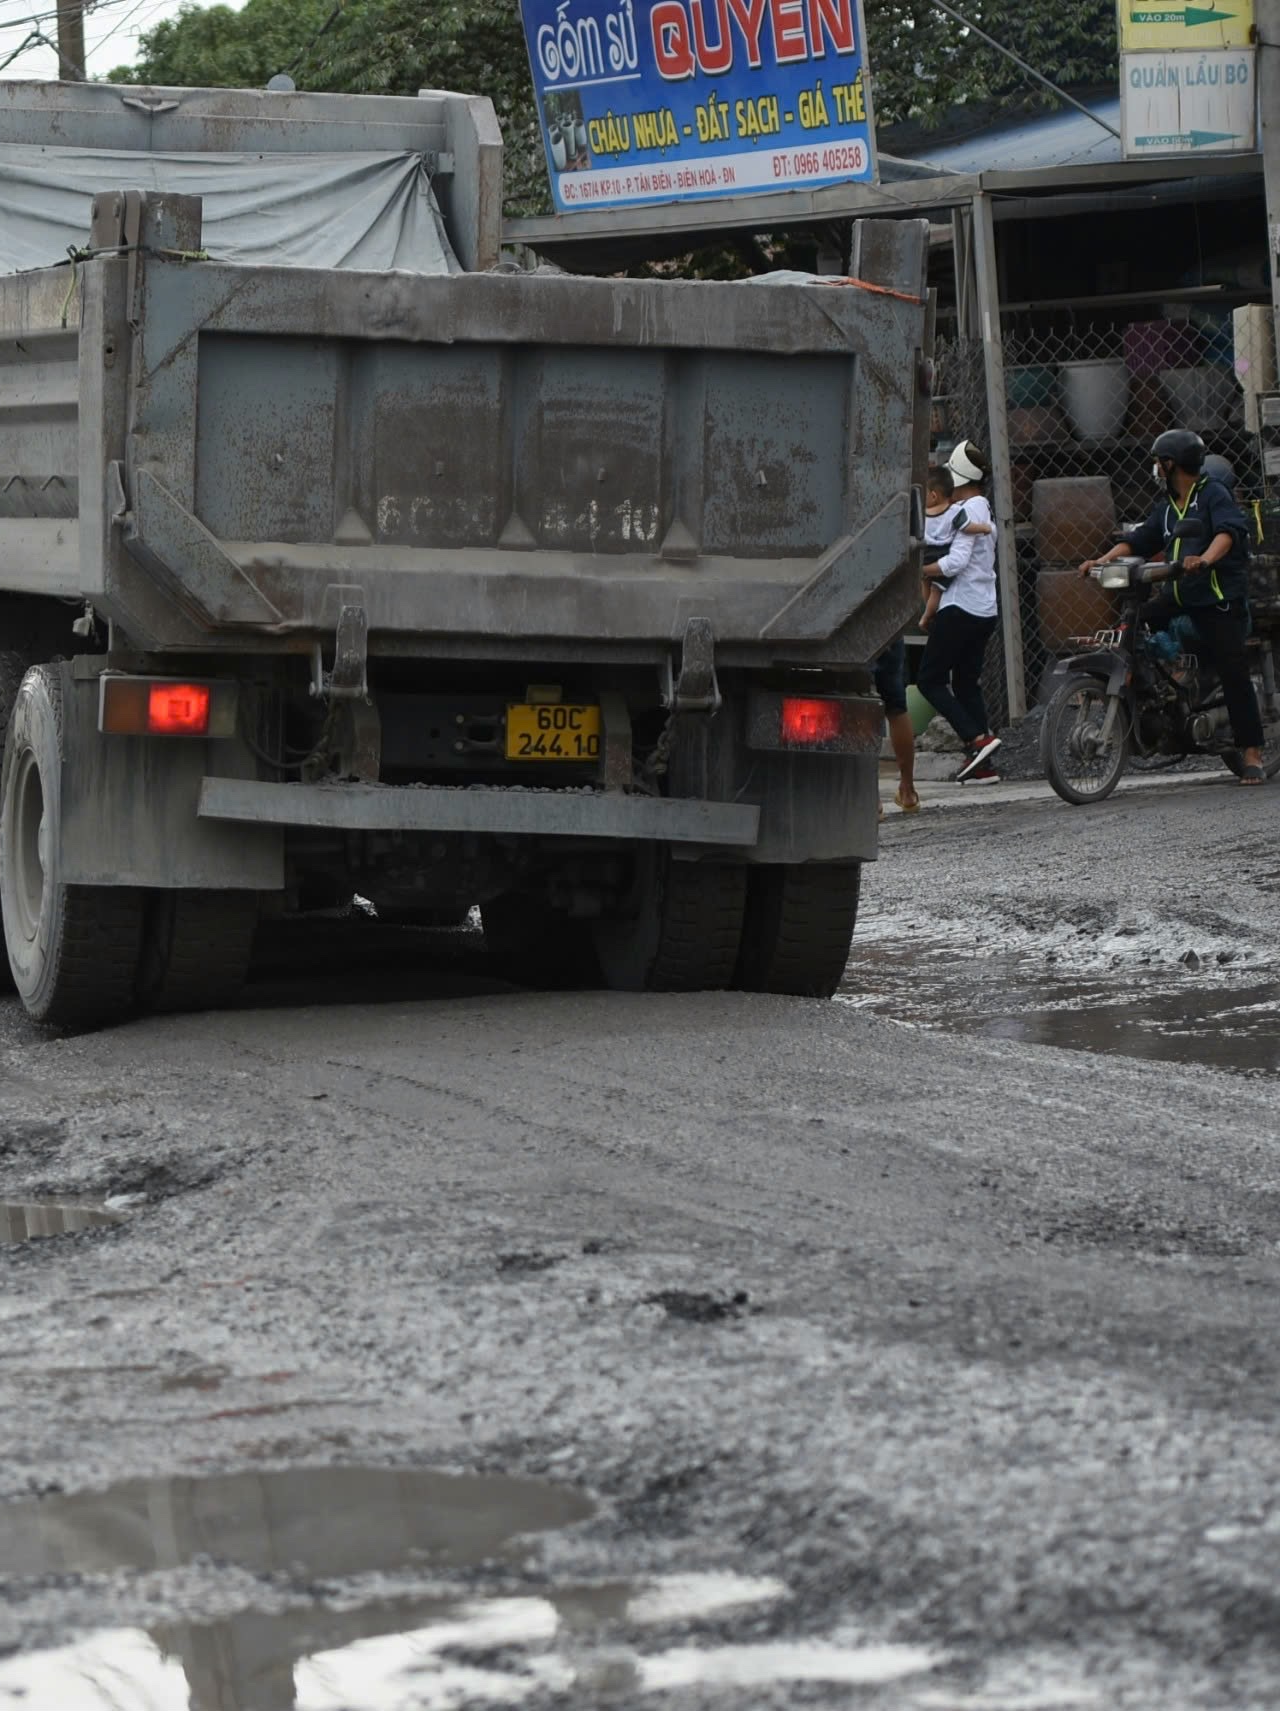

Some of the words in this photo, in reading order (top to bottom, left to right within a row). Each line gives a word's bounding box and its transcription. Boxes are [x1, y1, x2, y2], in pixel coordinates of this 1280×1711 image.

[696, 90, 730, 143] ĐẤT
[735, 94, 780, 144] SẠCH
[798, 78, 830, 129] GIÁ
[793, 151, 820, 176] 0966
[822, 145, 862, 172] 405258
[537, 707, 582, 731] 60C
[518, 732, 601, 757] 244.10
